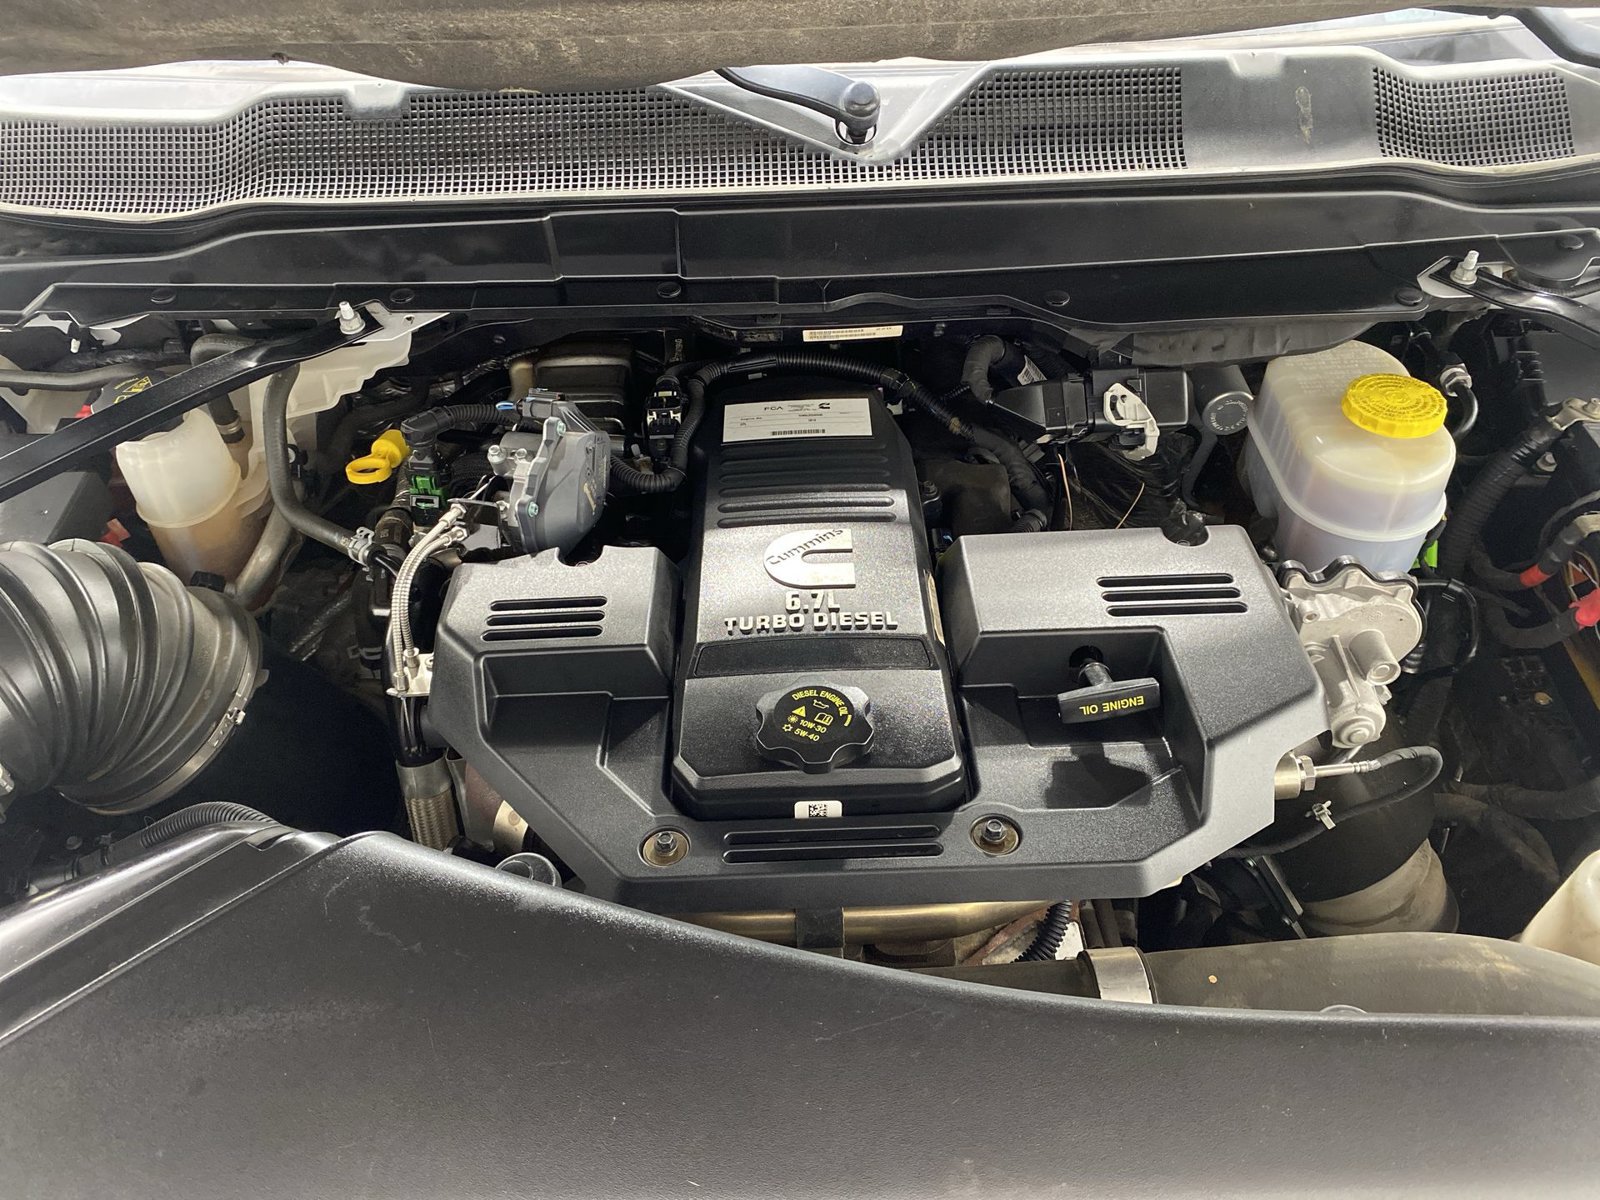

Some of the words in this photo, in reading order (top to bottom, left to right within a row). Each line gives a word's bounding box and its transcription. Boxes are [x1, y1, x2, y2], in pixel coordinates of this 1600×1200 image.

[766, 528, 844, 565] Cummins
[785, 590, 840, 613] 6.7L
[724, 613, 805, 636] TURBO
[814, 611, 898, 631] DIESEL
[791, 689, 818, 701] DIESEL
[819, 690, 845, 708] ENGINE
[838, 706, 850, 717] OIL
[1079, 704, 1098, 715] OIL
[1102, 695, 1144, 712] ENGINE
[793, 728, 820, 742] 5W-40
[799, 719, 827, 734] 10W-30
